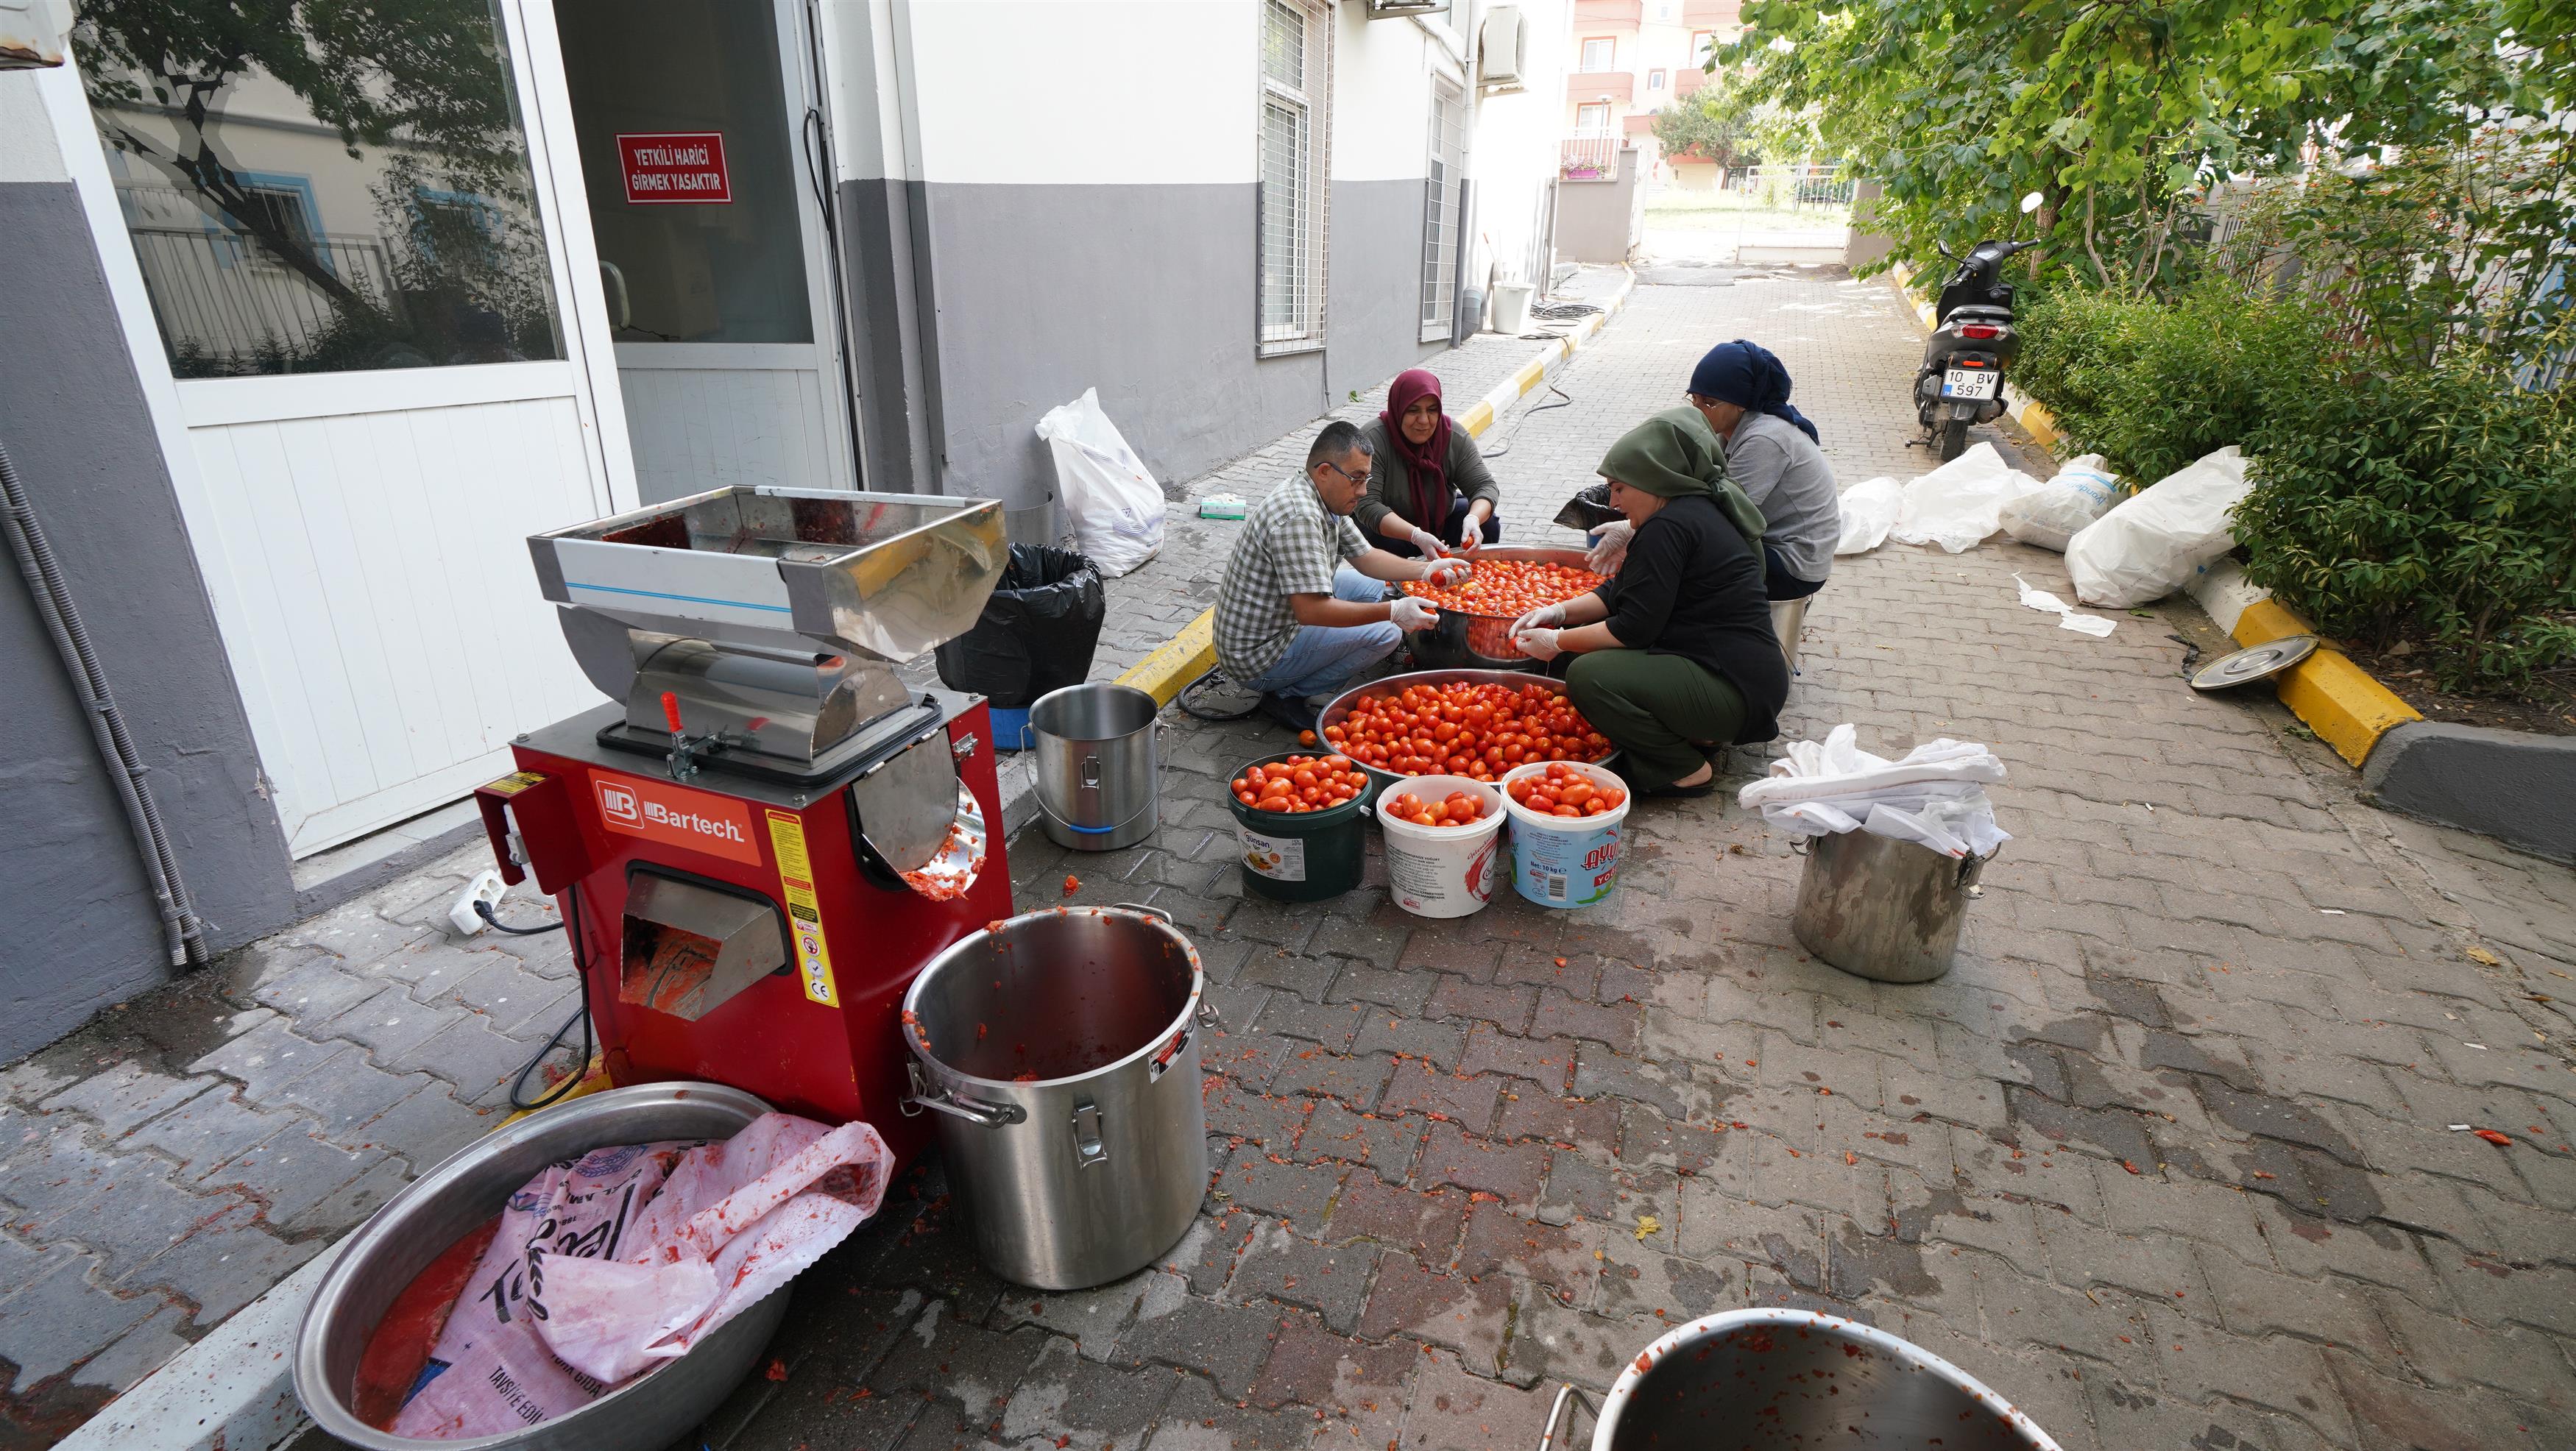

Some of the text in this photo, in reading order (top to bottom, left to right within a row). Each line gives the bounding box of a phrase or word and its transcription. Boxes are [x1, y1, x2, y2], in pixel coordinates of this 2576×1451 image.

[634, 143, 710, 166] YETKİLİ HARİCİ
[631, 170, 721, 191] GİRMEK YASAKTIR
[1950, 372, 1995, 384] 10 BV
[1957, 385, 1983, 397] 597
[643, 801, 745, 843] Bartech
[1245, 834, 1270, 848] günsan
[1530, 861, 1541, 869] Net:
[489, 1365, 526, 1408] TAVSİYE
